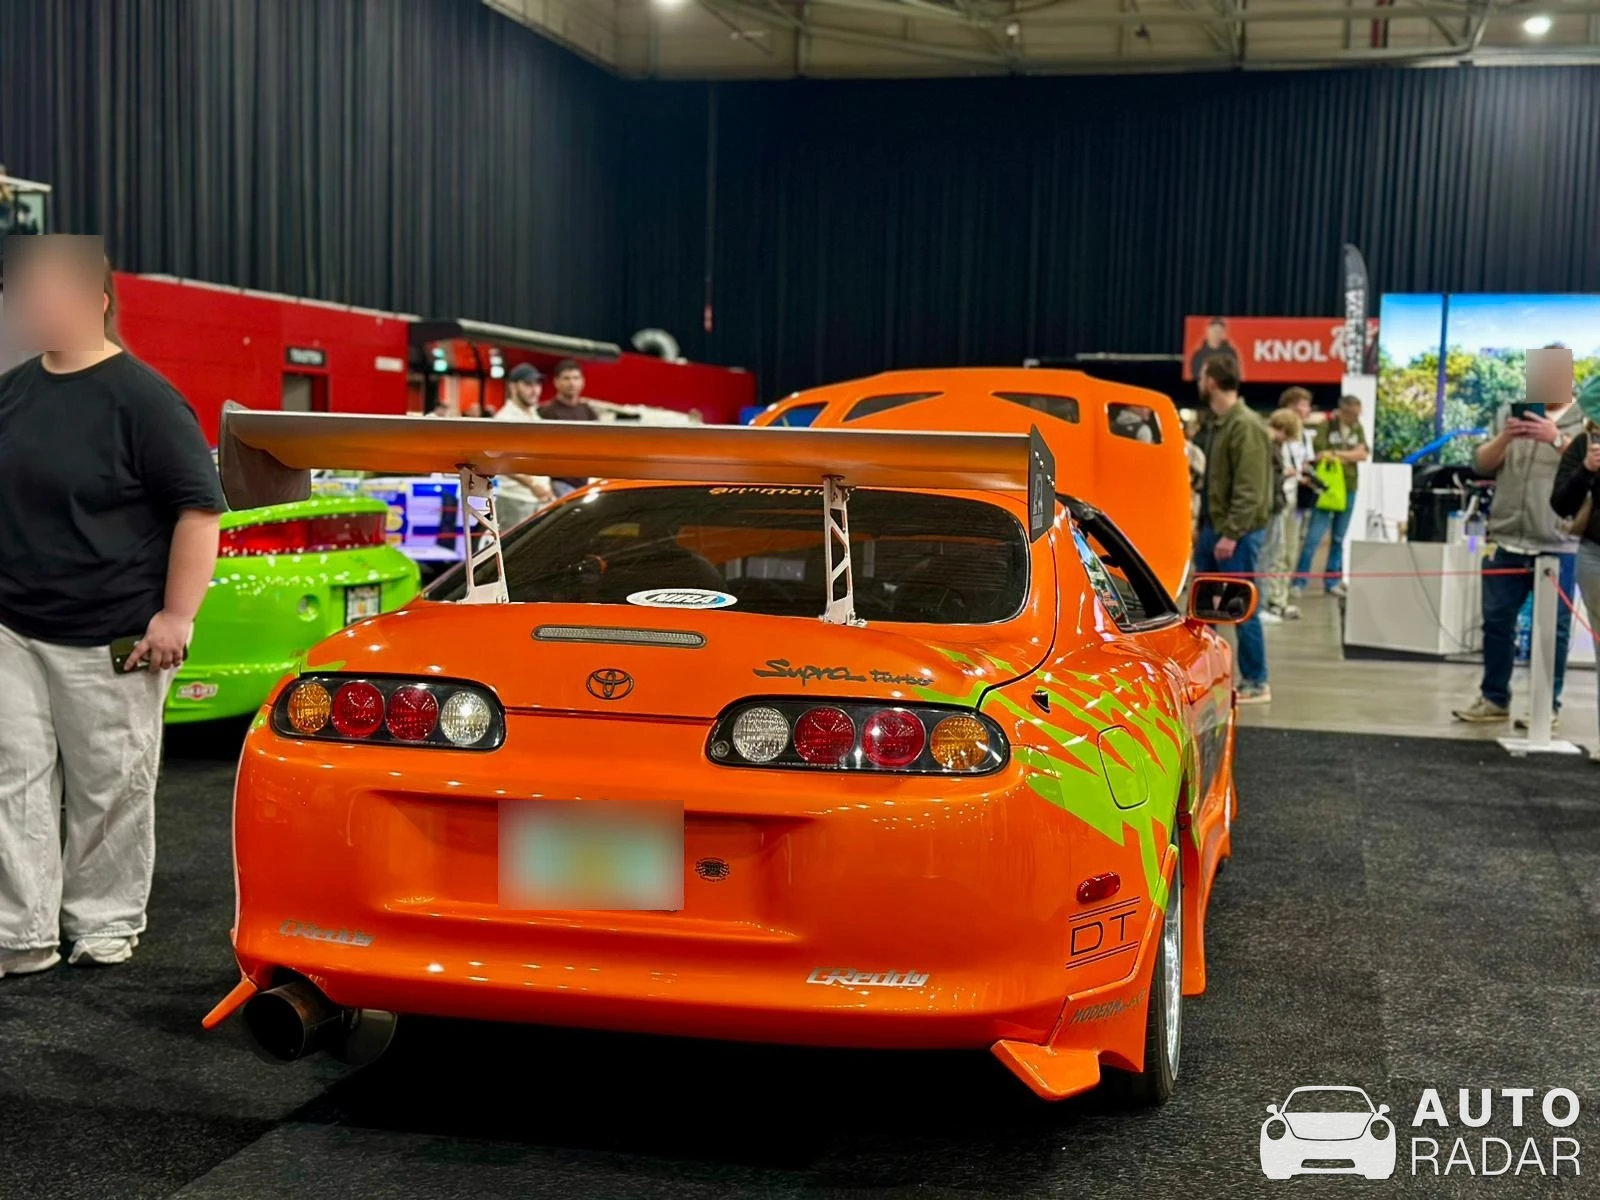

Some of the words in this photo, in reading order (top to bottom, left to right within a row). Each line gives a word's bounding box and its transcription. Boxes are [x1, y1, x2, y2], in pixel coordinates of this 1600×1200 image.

[1253, 338, 1328, 362] KNOL
[752, 658, 867, 687] Supra
[805, 966, 930, 987] GReddy
